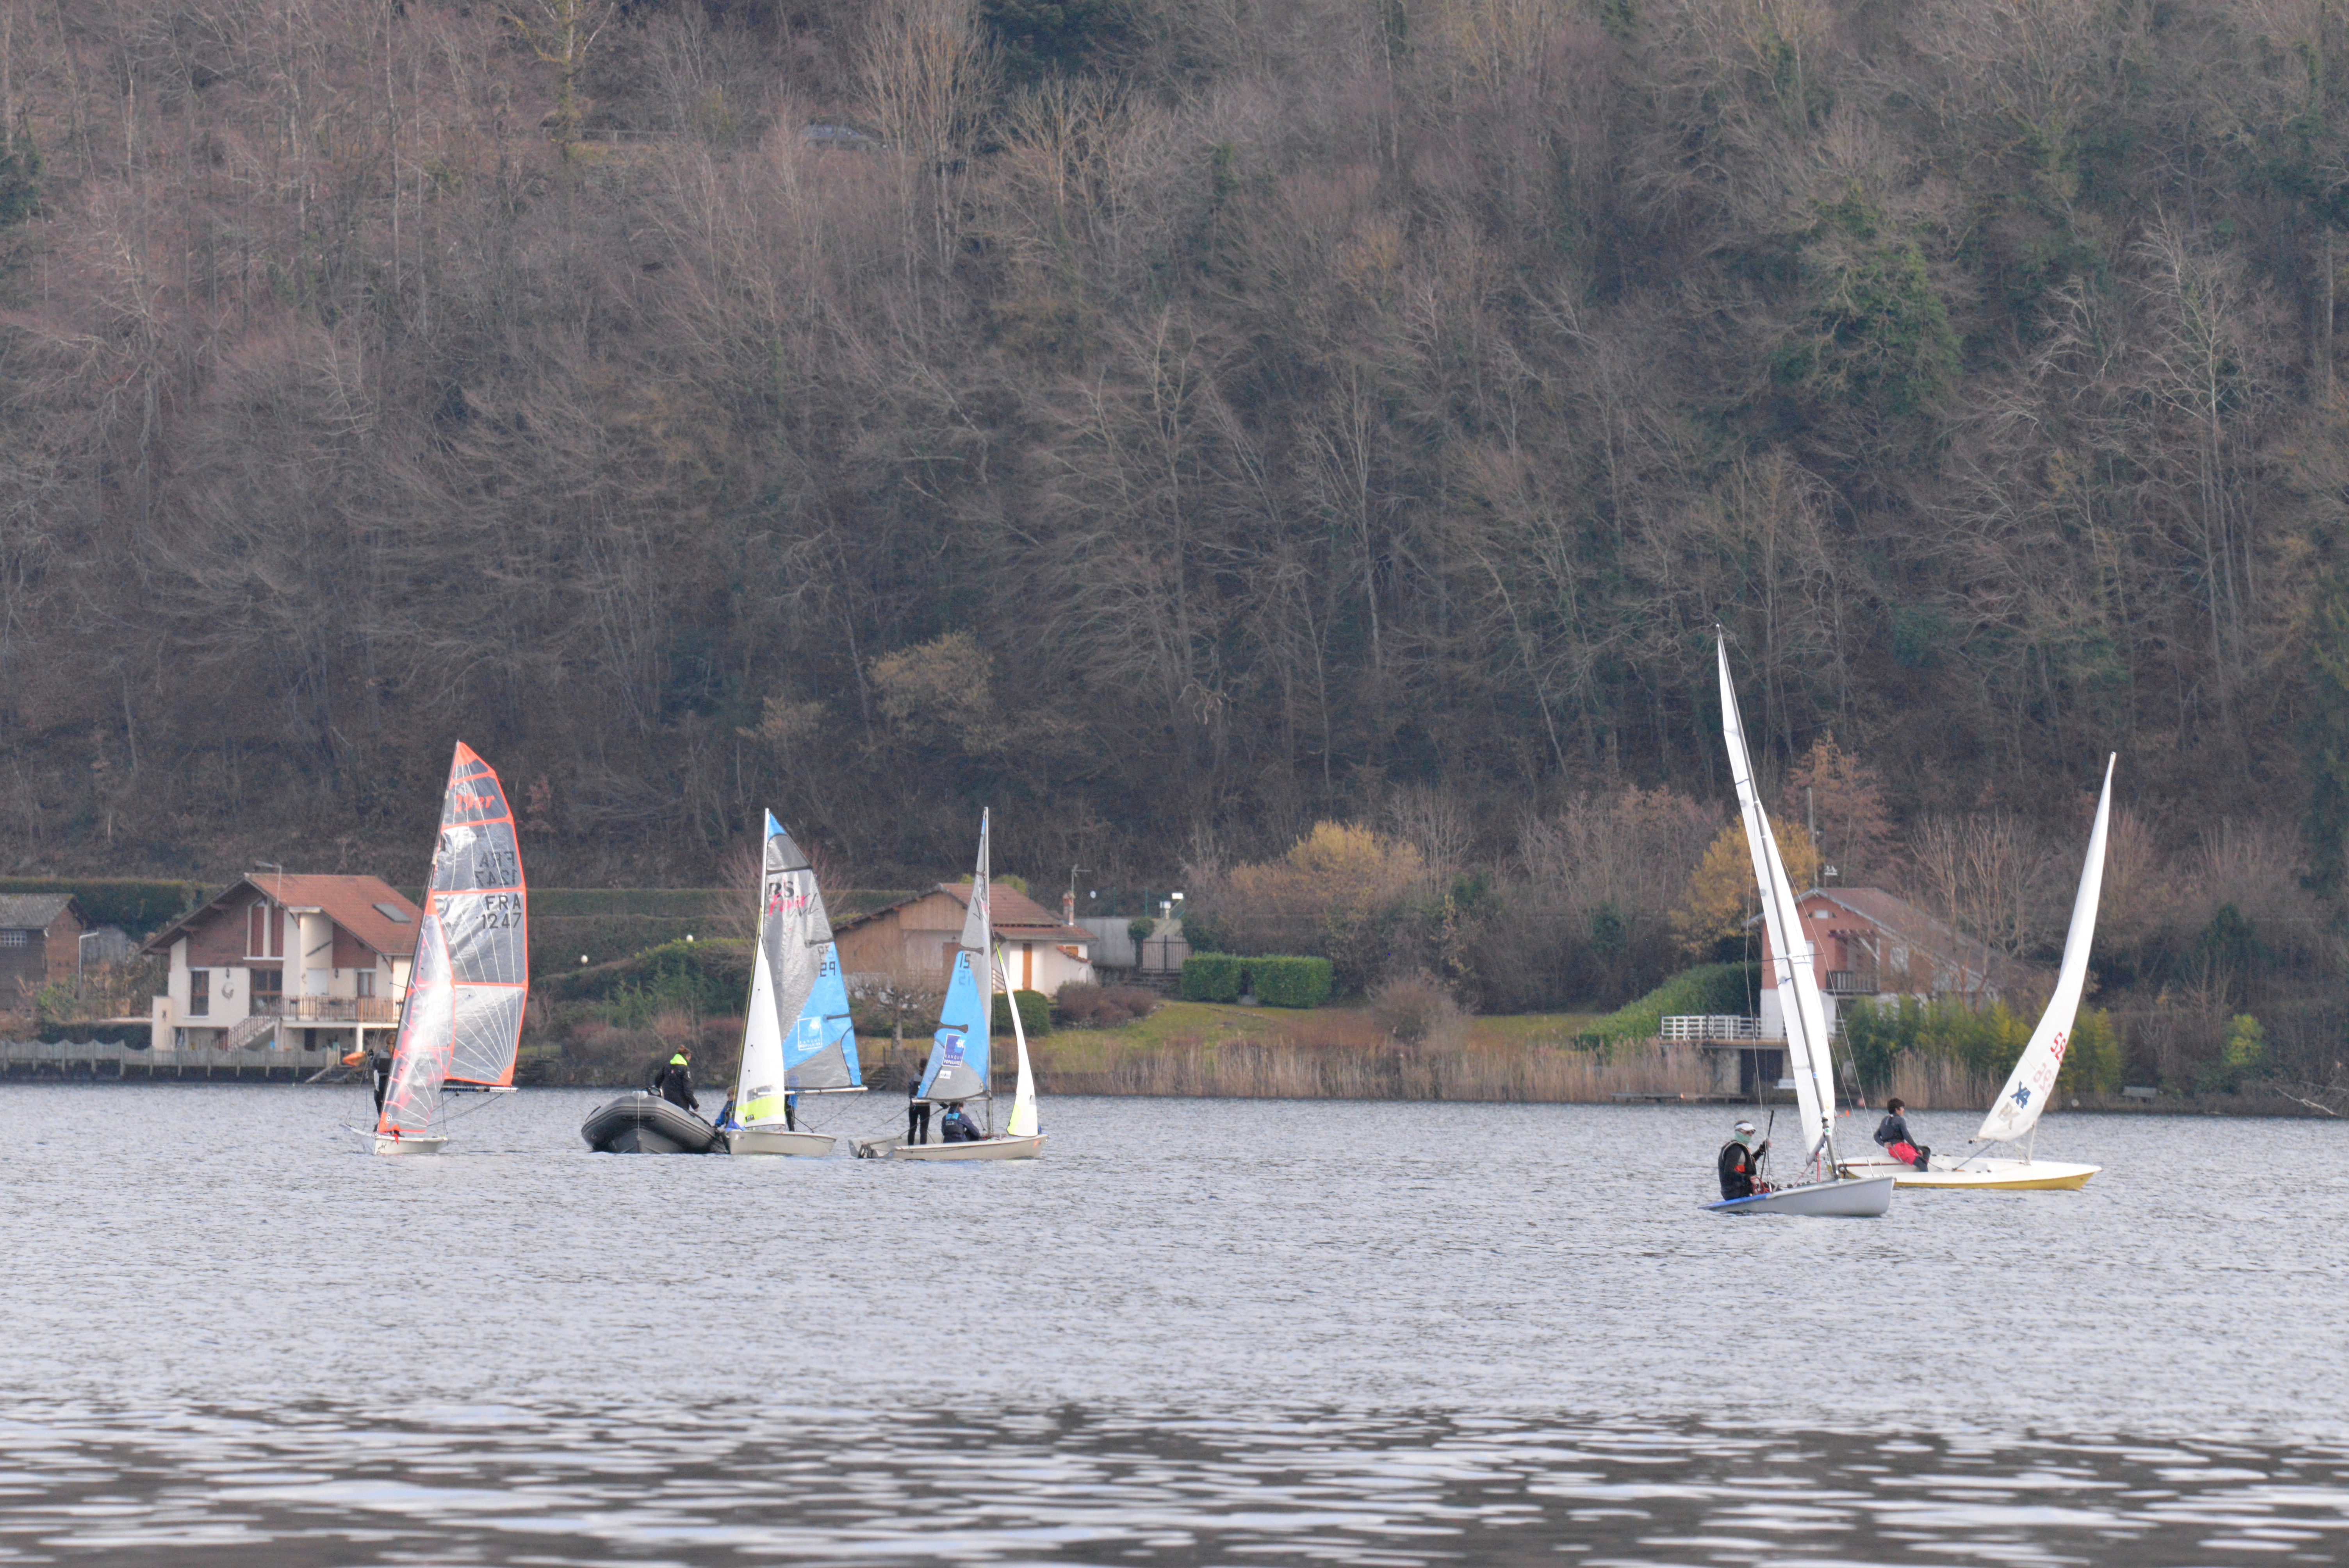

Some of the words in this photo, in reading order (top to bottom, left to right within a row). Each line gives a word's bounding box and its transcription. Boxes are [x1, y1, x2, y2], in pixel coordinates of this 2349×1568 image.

[454, 792, 495, 812] 29er
[485, 894, 521, 910] FRA
[481, 912, 521, 928] 1247
[820, 961, 835, 977] 29
